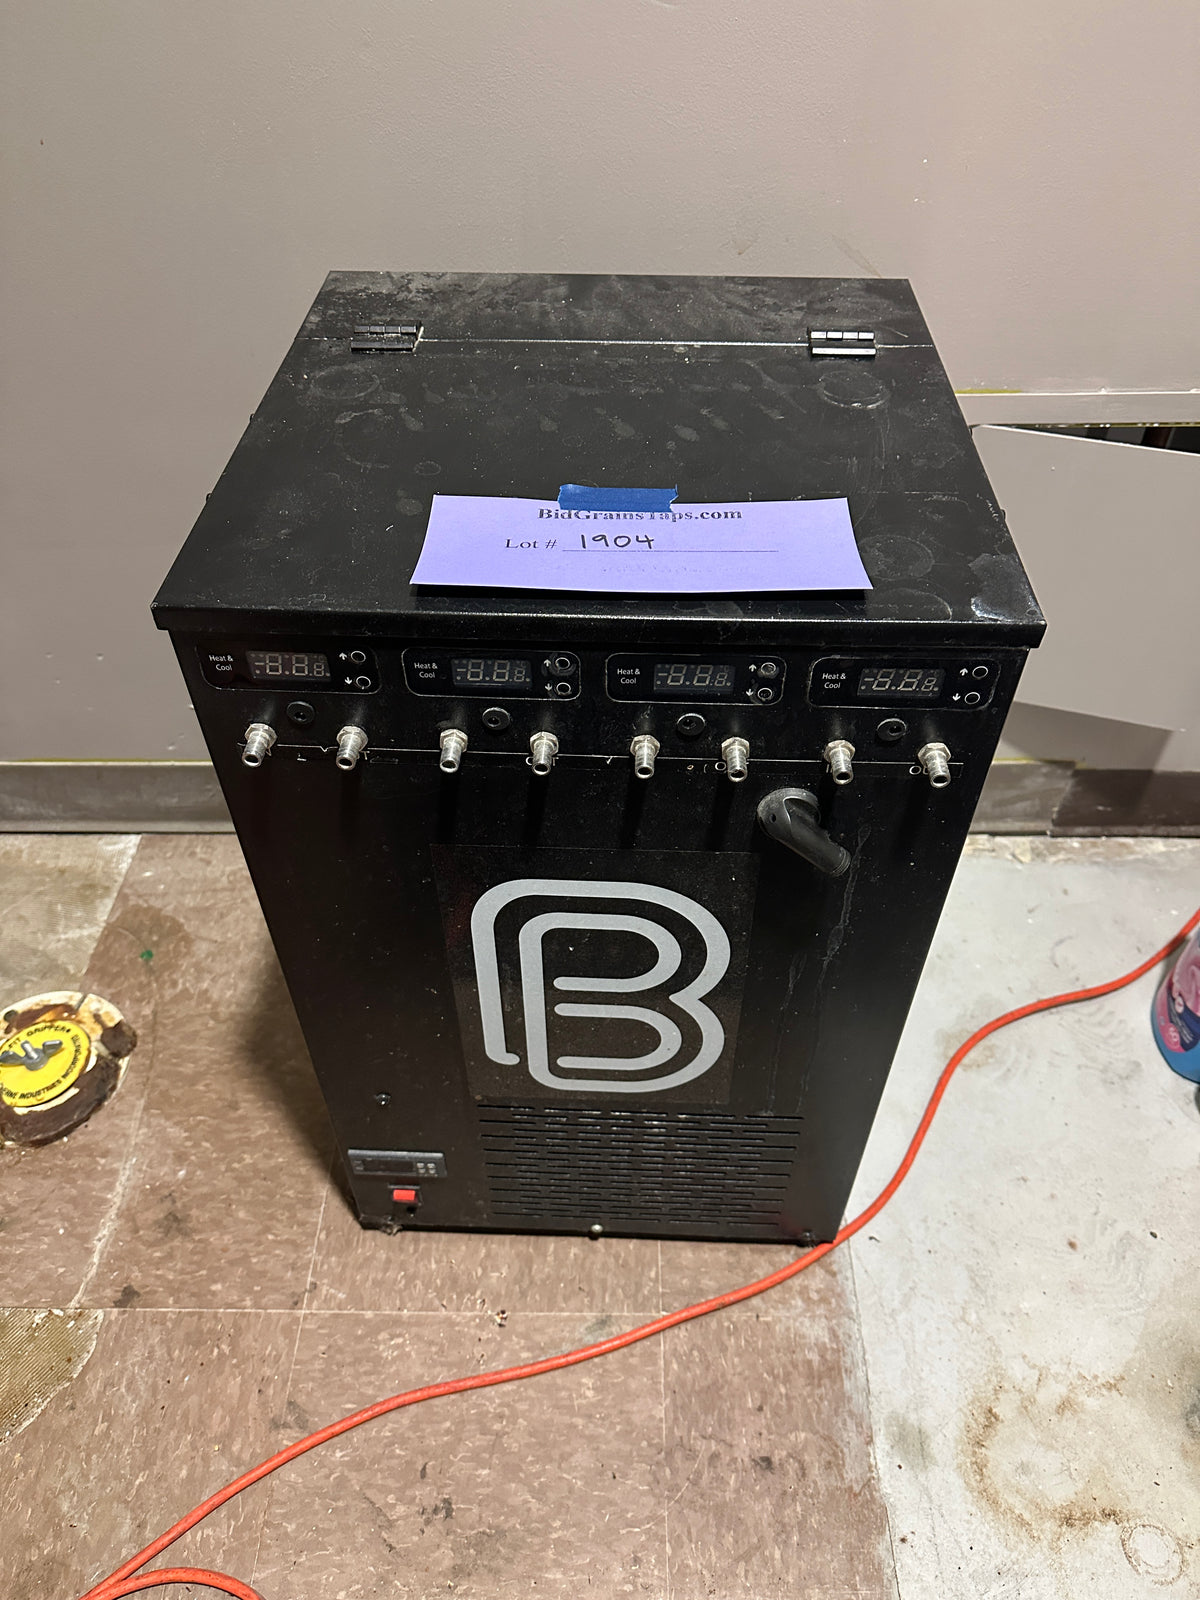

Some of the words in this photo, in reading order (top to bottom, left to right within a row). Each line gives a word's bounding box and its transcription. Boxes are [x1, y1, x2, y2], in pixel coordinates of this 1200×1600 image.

[505, 538, 539, 549] Lot
[545, 539, 558, 549] #
[581, 534, 654, 550] 1904
[824, 681, 841, 689] Cool
